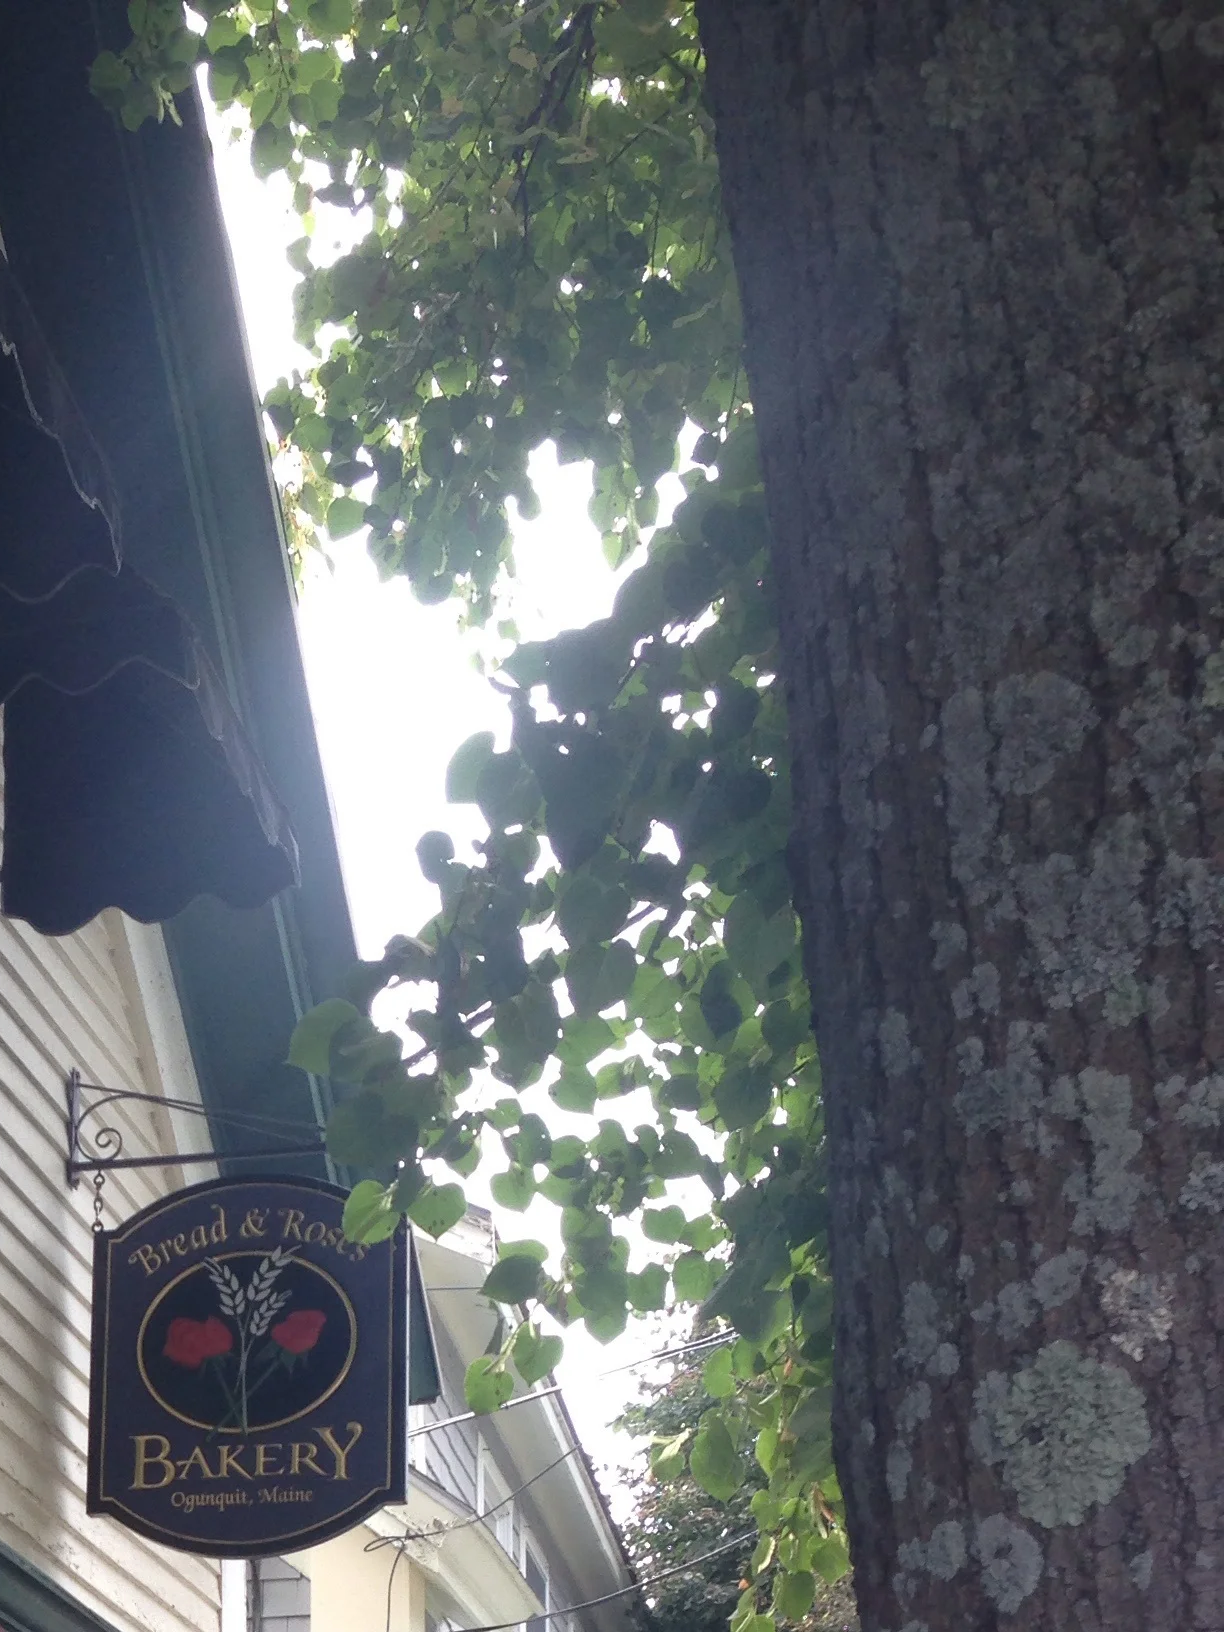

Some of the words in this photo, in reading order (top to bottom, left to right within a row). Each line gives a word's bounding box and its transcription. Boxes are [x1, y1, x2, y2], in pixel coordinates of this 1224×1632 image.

[128, 1204, 228, 1276] Bread
[239, 1207, 271, 1238] &
[128, 1421, 363, 1490] BAKERY
[258, 1487, 313, 1503] Maine
